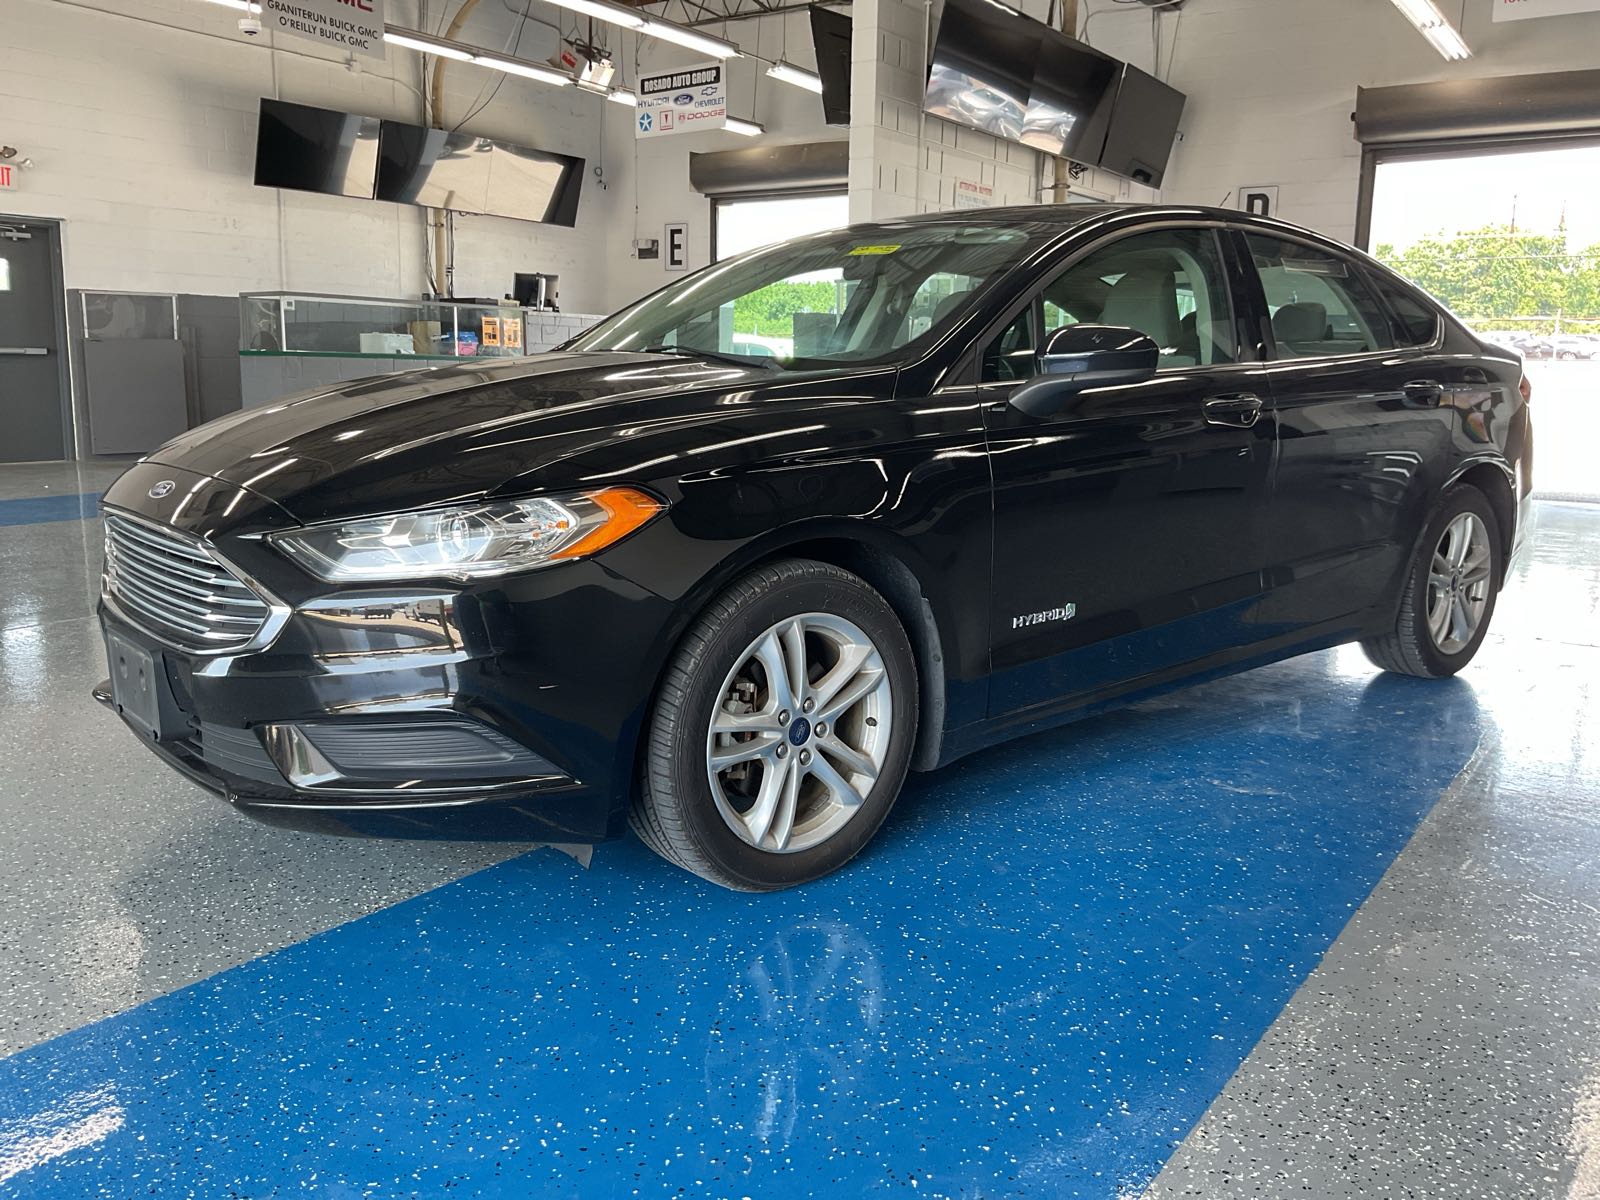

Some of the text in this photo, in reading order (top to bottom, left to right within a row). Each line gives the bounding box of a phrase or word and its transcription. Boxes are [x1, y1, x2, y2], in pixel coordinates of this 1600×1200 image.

[267, 0, 327, 25] GRANITERUN
[329, 17, 356, 33] BUICK
[357, 26, 378, 40] GMC
[279, 16, 369, 49] O'REILLY BUICK GMC
[644, 70, 716, 92] ROSADO AUTO GROUP
[694, 97, 725, 108] CHEVROLET
[687, 109, 725, 120] DODGE
[0, 167, 11, 186] IT
[670, 229, 682, 265] E
[1012, 608, 1065, 629] HYBRID
